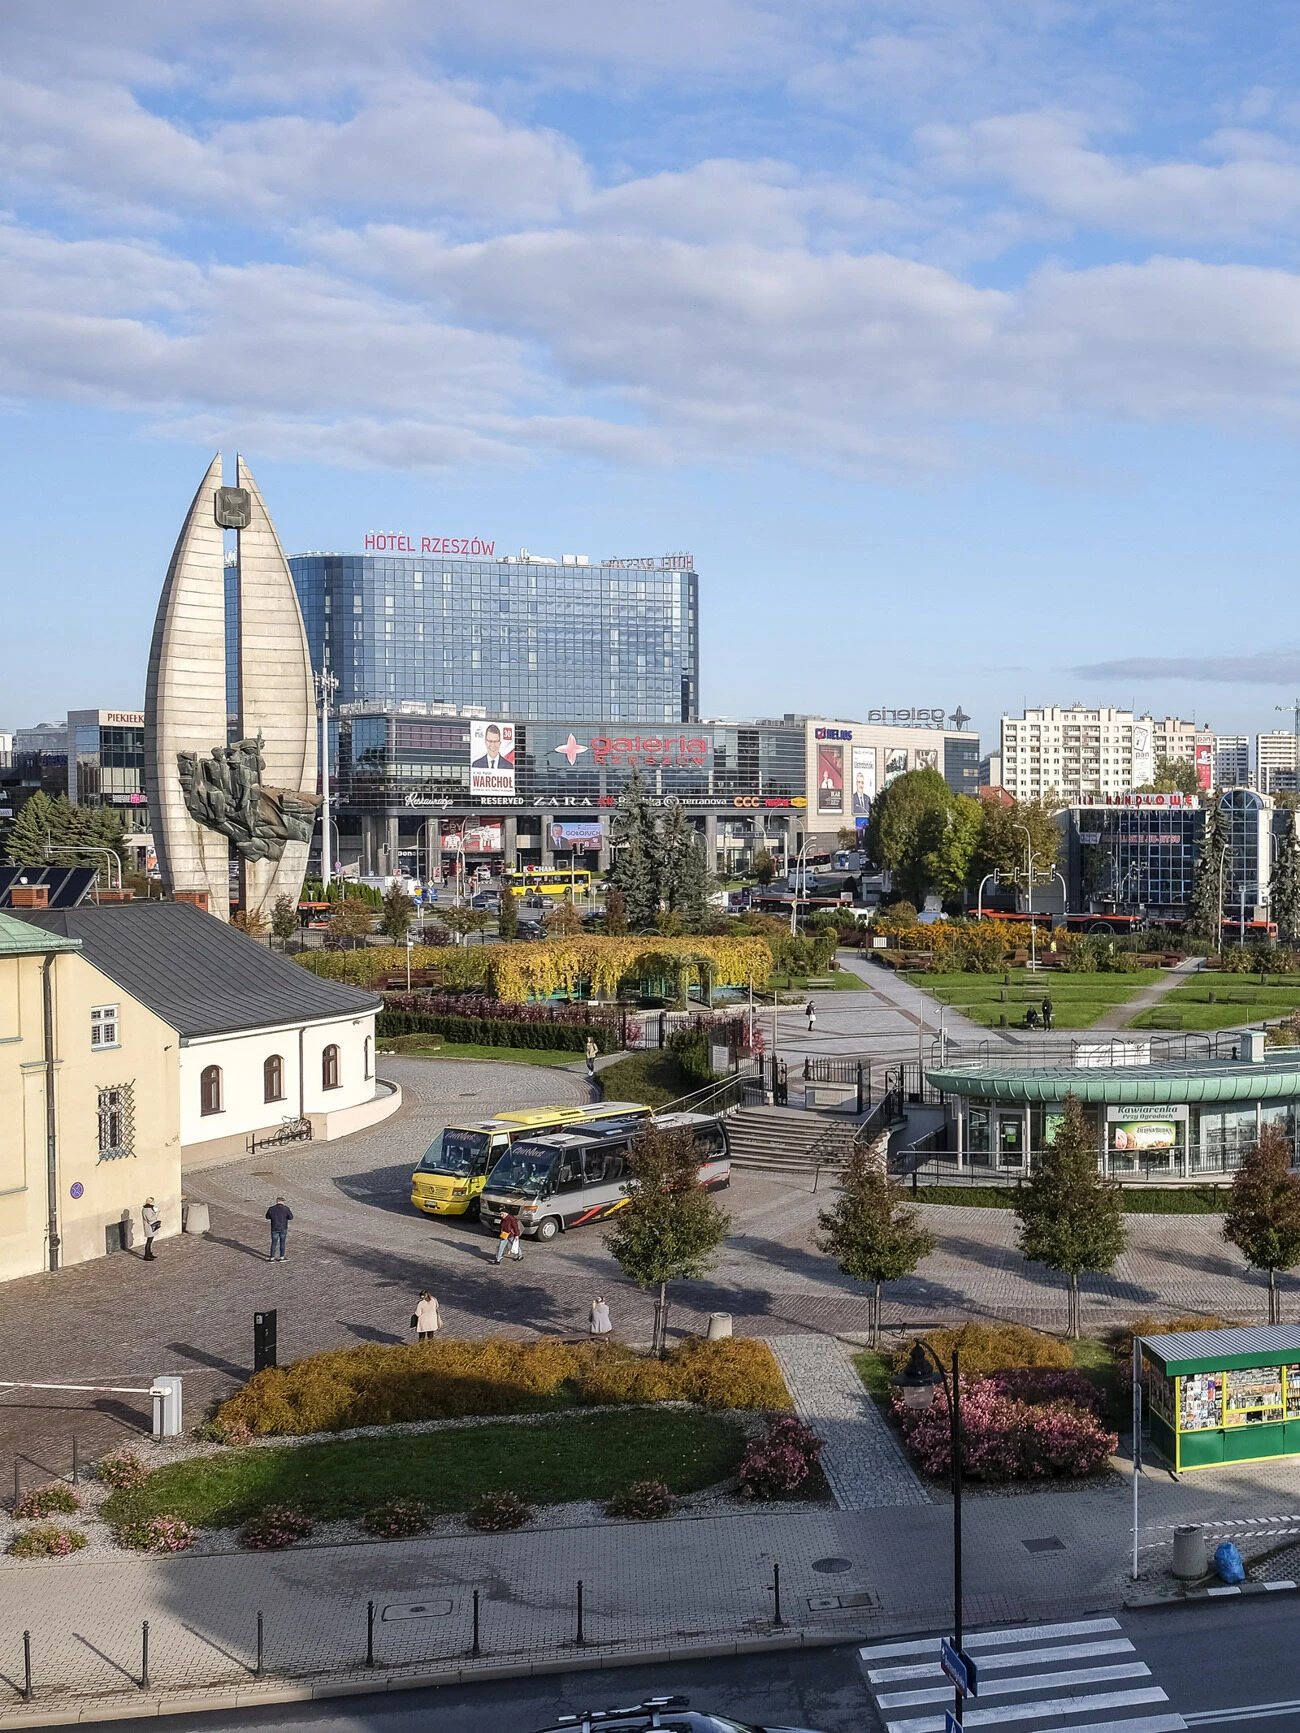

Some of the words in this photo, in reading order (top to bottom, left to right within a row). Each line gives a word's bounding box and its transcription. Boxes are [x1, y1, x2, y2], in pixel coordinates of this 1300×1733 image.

[365, 534, 416, 552] HOTEL
[421, 536, 496, 556] RZESZÓW
[504, 730, 512, 738] 30
[826, 729, 853, 741] HELIOS
[591, 735, 707, 755] galeria
[594, 754, 706, 765] RZESZÓW
[472, 775, 514, 789] WARCHOŁ
[480, 797, 524, 805] RESERVED
[533, 796, 592, 806] ZARA
[733, 796, 760, 807] CCC
[1117, 1104, 1178, 1114] Kawiarenka
